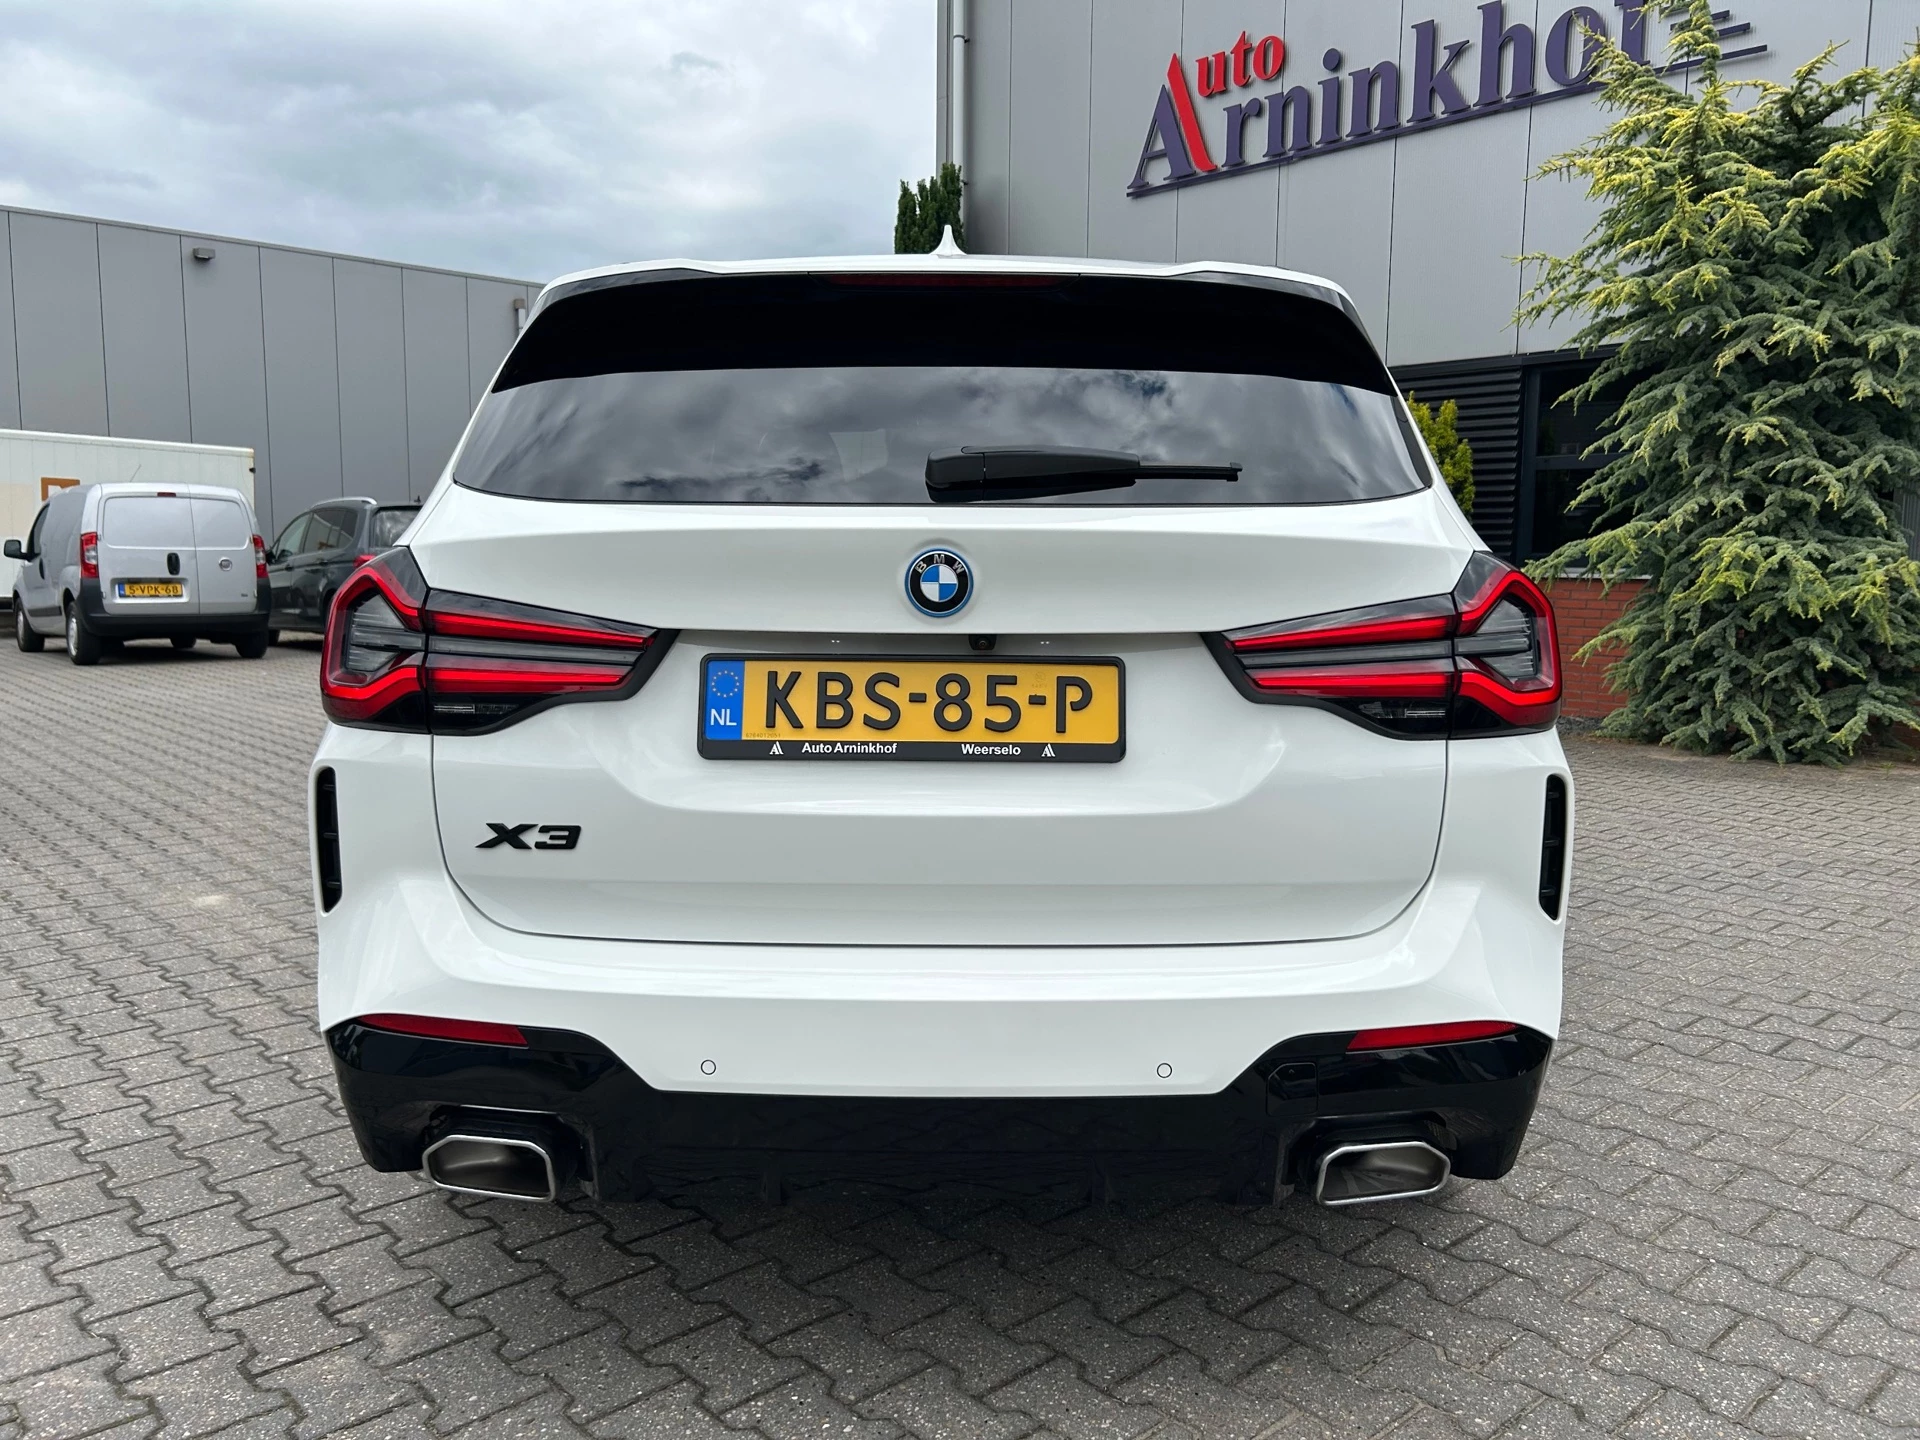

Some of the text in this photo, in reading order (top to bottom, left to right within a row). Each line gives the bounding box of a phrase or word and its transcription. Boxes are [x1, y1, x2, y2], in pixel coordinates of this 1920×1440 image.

[914, 553, 965, 574] BMW
[765, 670, 1093, 733] KBS-85-P
[709, 708, 737, 726] NL
[801, 742, 832, 754] Auto
[834, 742, 898, 754] Arninkhof
[961, 743, 1022, 755] Weerselo
[474, 822, 582, 850] X3
